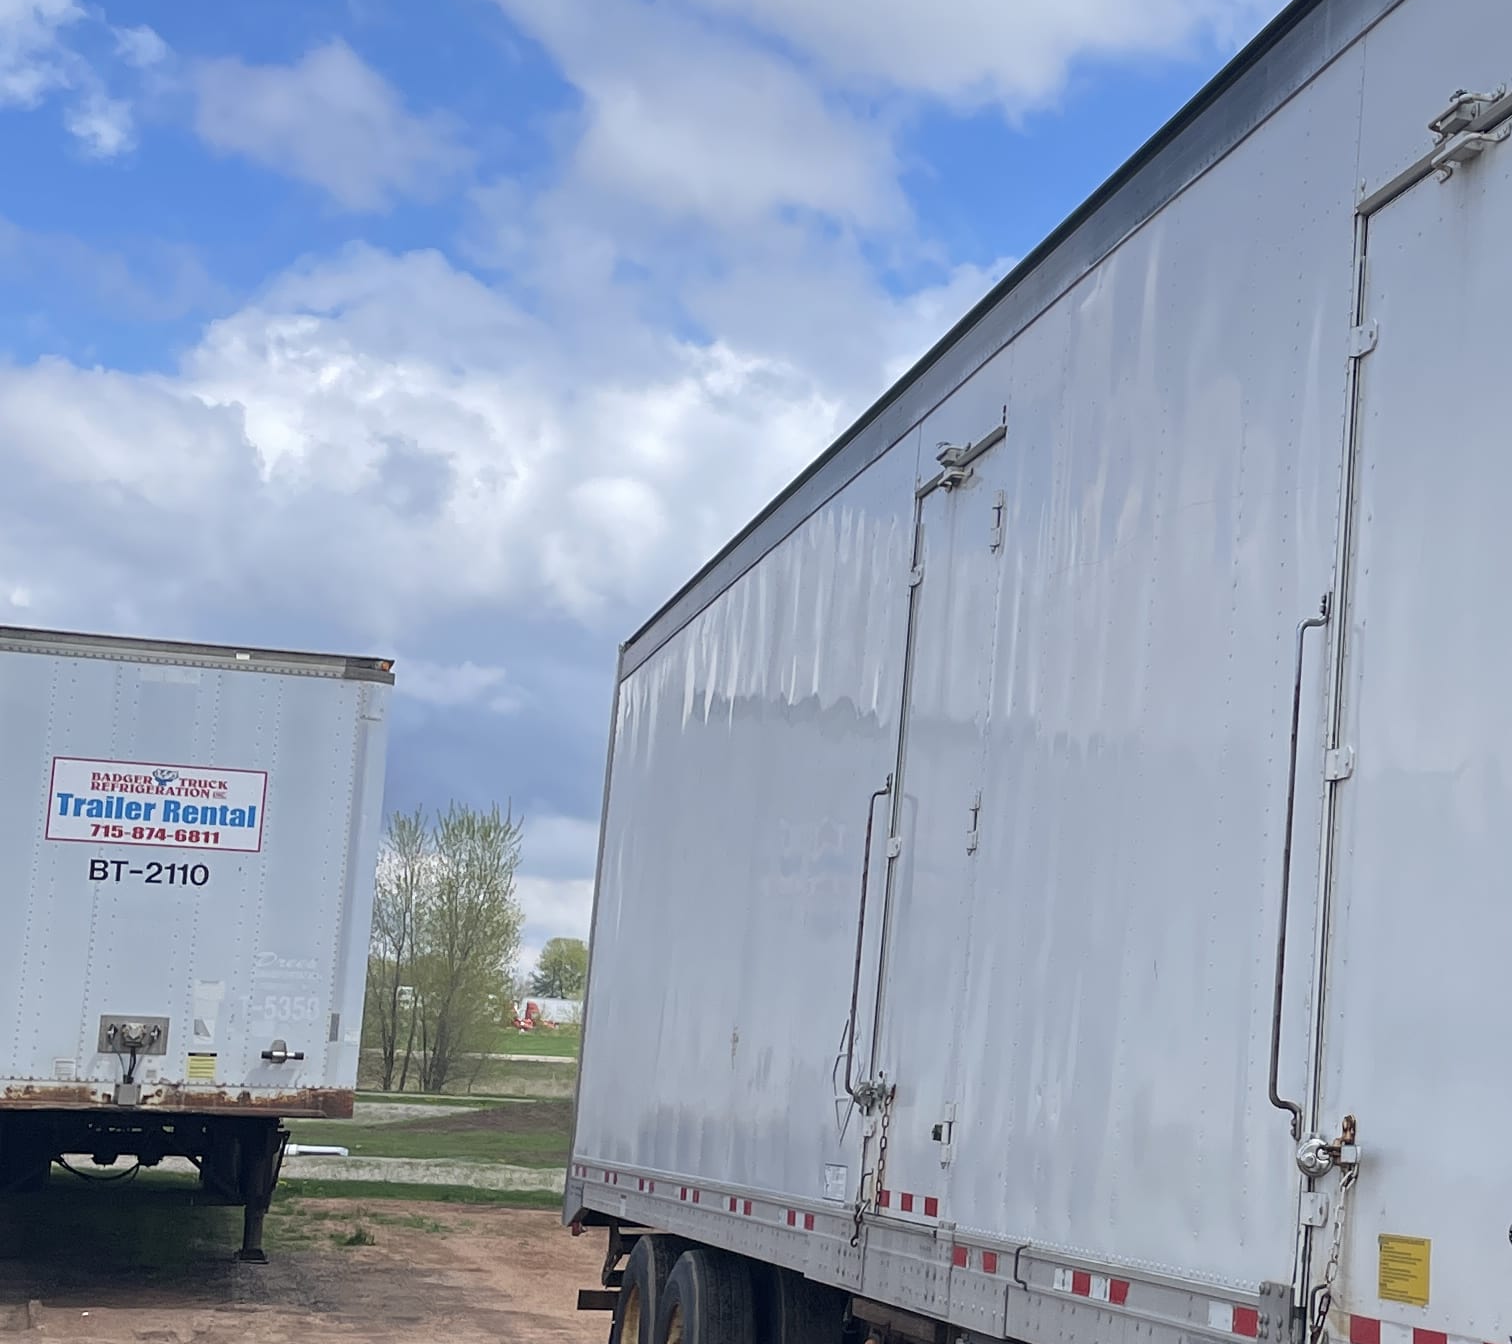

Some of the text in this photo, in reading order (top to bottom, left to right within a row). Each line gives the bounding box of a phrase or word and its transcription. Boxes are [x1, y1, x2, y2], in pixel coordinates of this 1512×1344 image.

[90, 781, 210, 799] REFRIGERATION
[91, 772, 228, 790] BADGER TRUCK
[56, 792, 257, 828] Trailer Rental
[90, 824, 220, 844] 715-874-6811
[89, 859, 209, 886] BT-2110
